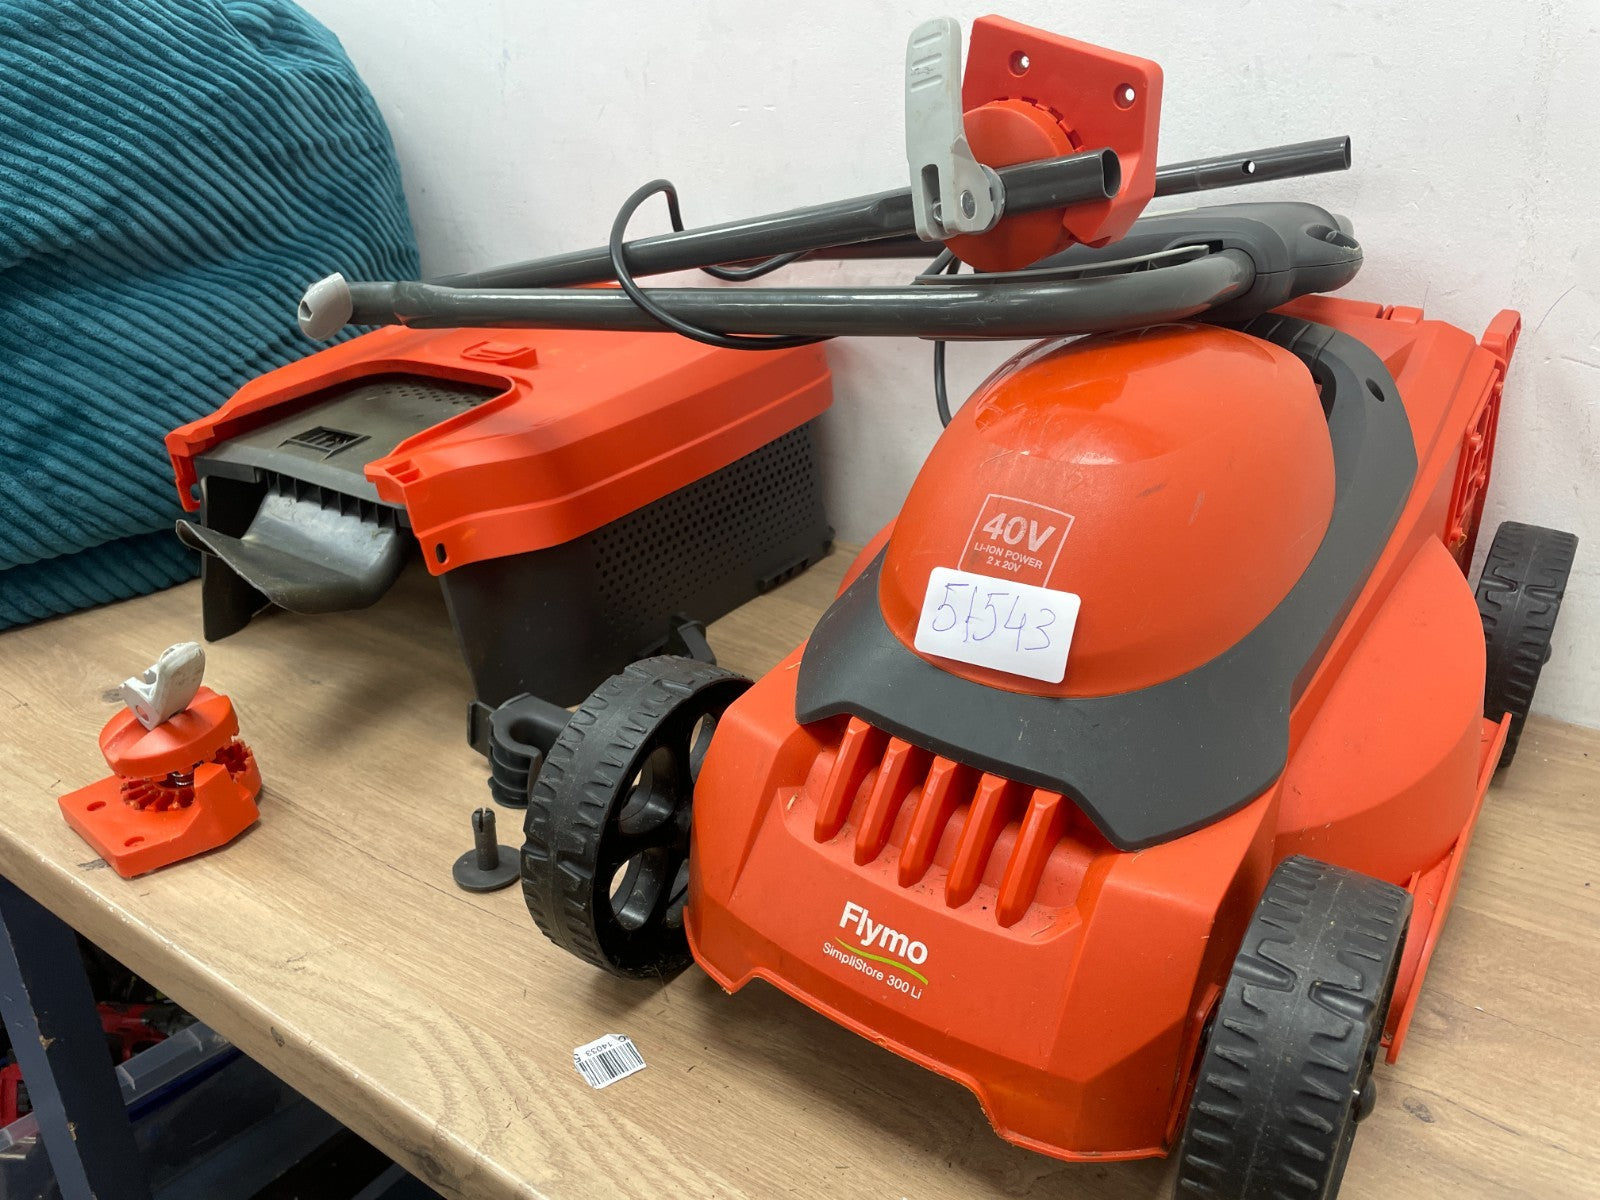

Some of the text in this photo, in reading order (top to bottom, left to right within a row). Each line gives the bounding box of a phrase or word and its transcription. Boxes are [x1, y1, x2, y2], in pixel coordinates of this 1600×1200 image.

[982, 512, 1056, 552] 40V
[974, 542, 1043, 570] LI-ION POWER
[986, 555, 994, 565] 2
[1002, 561, 1022, 572] 20V
[839, 900, 928, 965] Flymo
[822, 942, 922, 1000] SimpliStore 300 Li
[585, 1042, 613, 1056] 14033
